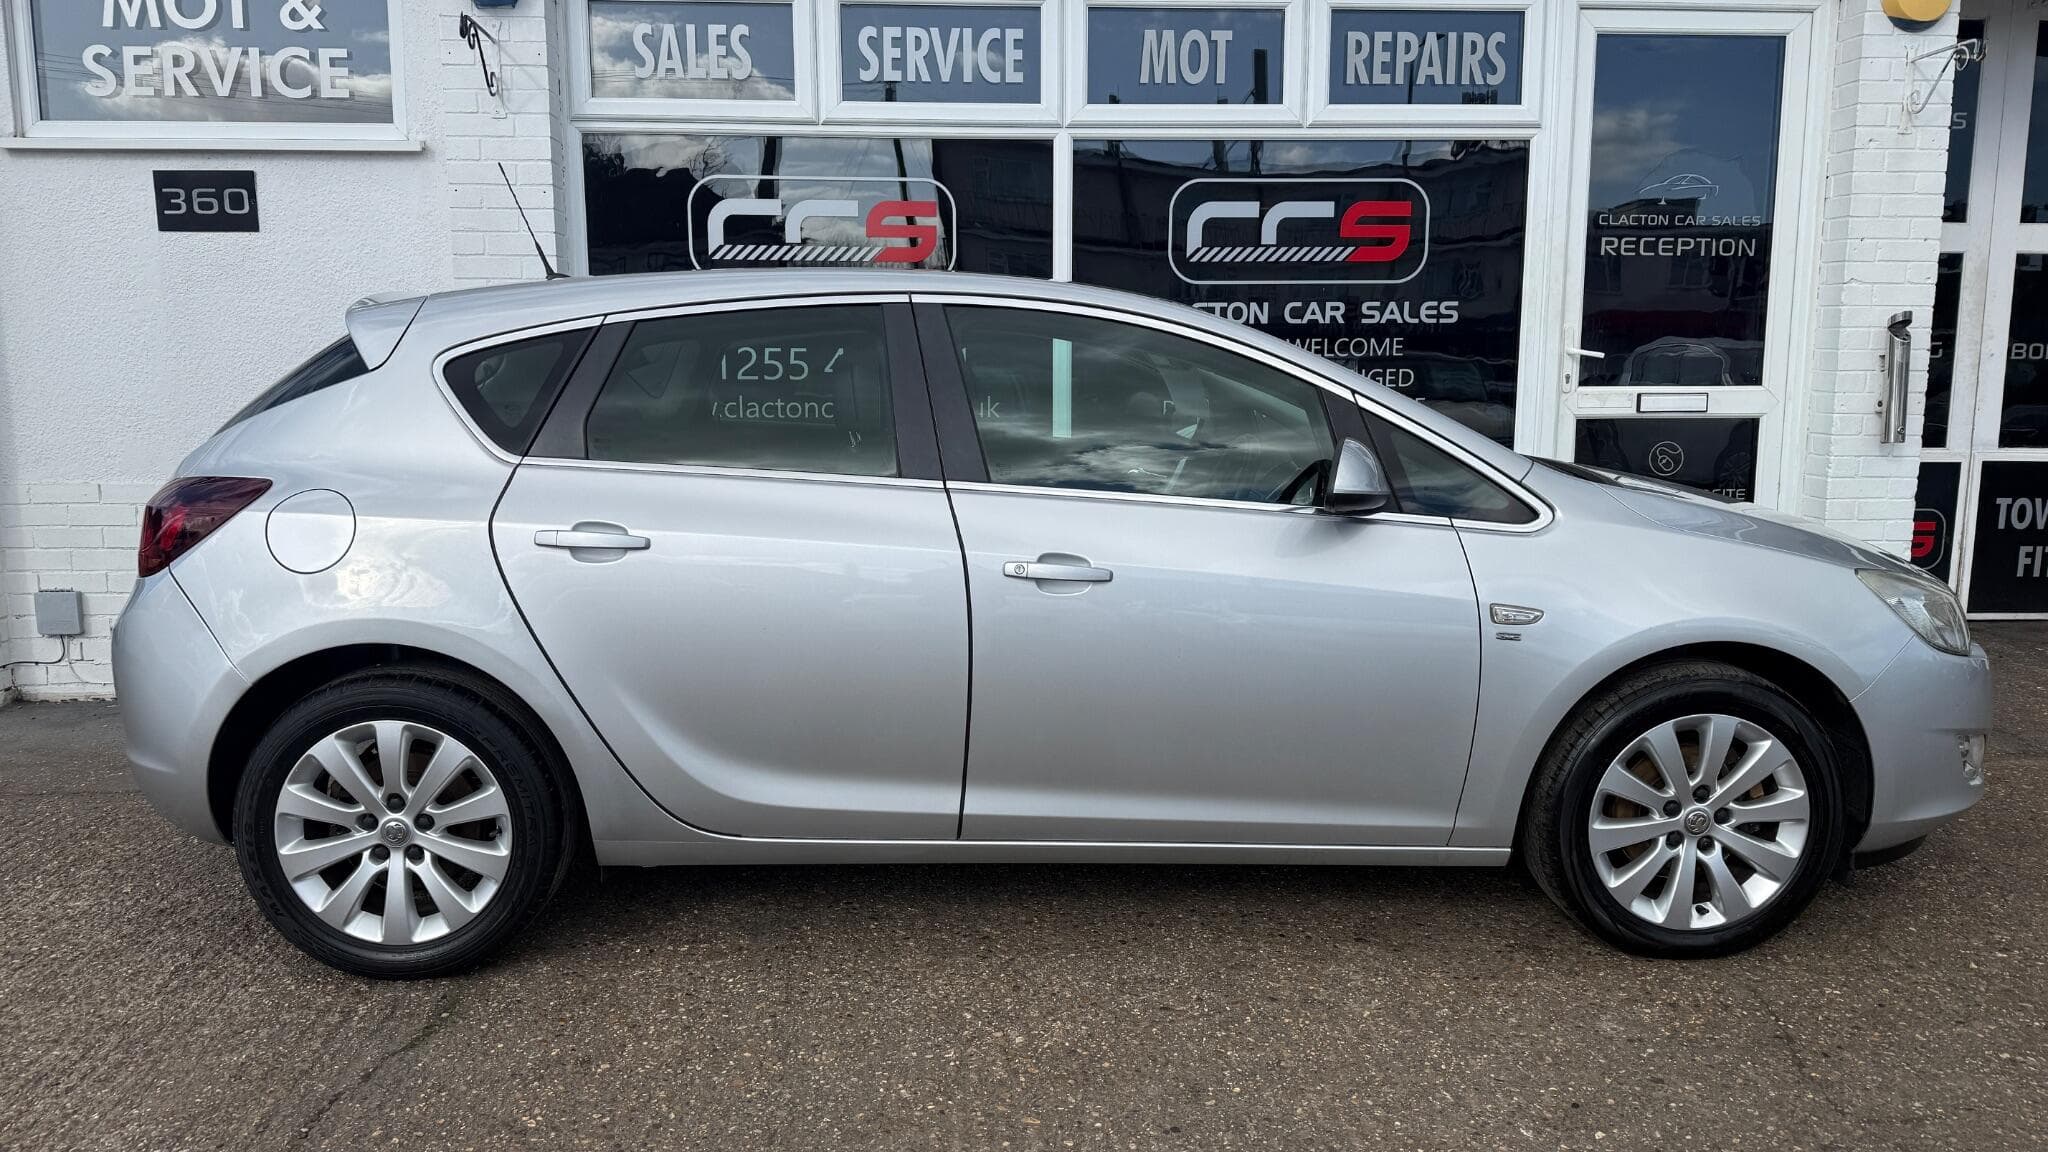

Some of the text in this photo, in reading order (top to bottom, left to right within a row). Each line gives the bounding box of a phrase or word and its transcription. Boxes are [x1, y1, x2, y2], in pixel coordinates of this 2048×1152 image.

[101, 0, 325, 30] MOT &
[633, 23, 751, 79] SALES
[858, 25, 1024, 83] SERVICE
[1140, 29, 1233, 84] MOT
[1345, 31, 1506, 85] REPAIRS
[82, 44, 349, 98] SERVICE
[162, 188, 249, 214] 360
[1599, 214, 1761, 227] CLACTON CAR SALES
[1600, 237, 1756, 257] RECEPTION
[1284, 301, 1344, 324] CAR
[1361, 301, 1459, 323] SALES
[2011, 343, 2048, 359] BO
